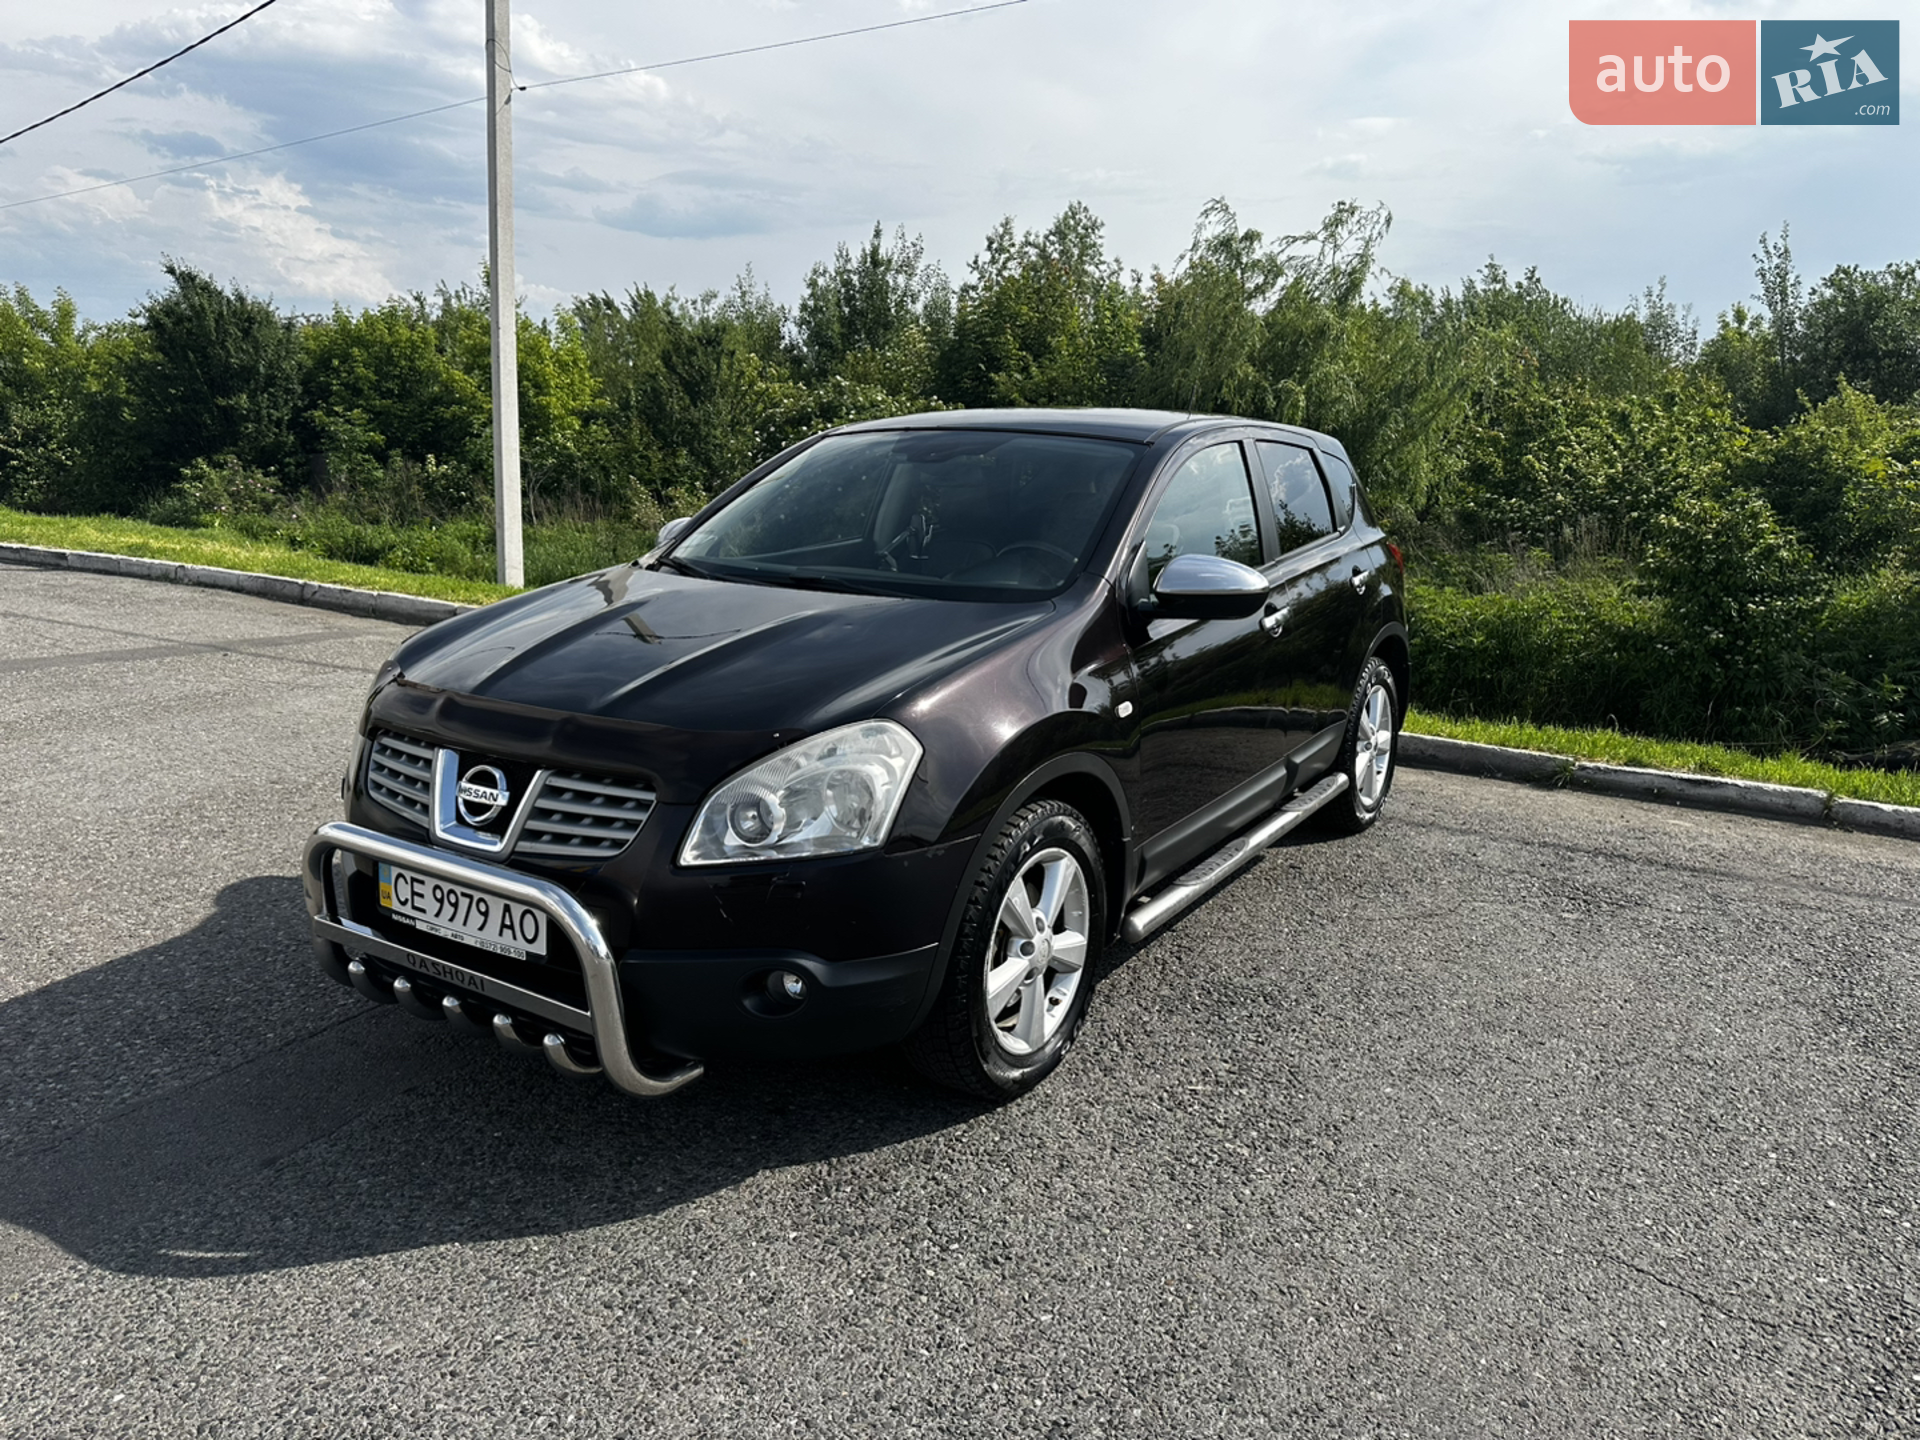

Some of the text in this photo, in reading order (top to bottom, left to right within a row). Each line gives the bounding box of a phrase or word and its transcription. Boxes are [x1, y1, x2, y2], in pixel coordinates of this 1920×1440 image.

[381, 889, 392, 901] UA
[394, 872, 540, 945] CE 9979 AO
[406, 952, 485, 992] QASHQAI
